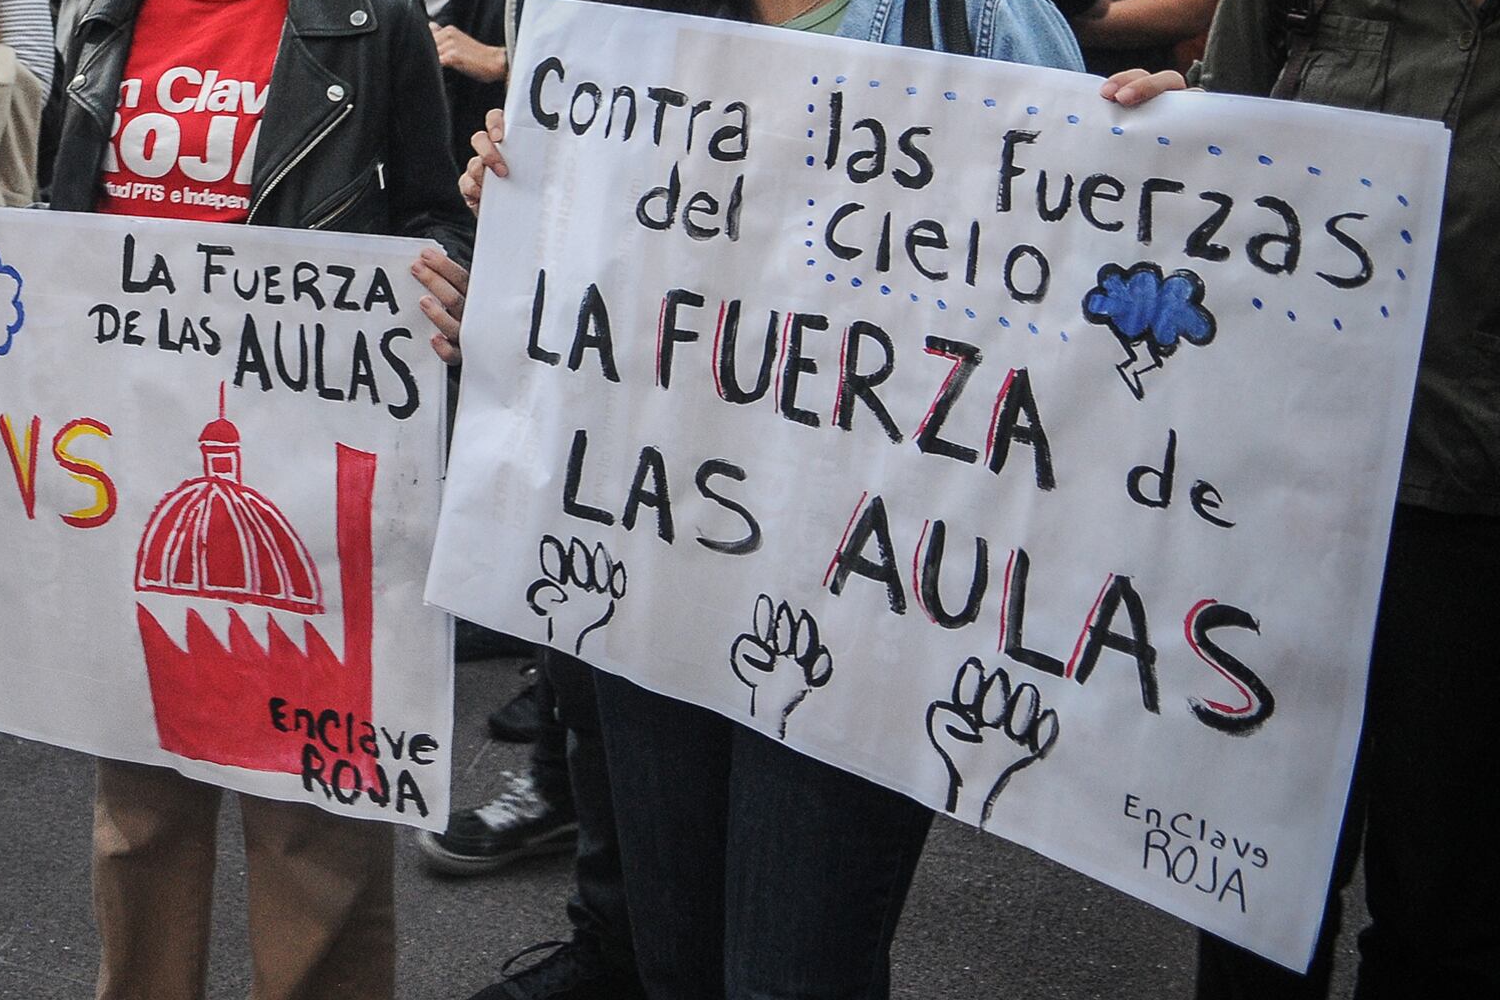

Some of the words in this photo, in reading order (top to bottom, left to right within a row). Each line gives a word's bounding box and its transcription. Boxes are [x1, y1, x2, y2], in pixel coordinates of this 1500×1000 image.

[156, 66, 270, 114] Clav
[824, 89, 936, 189] las
[132, 183, 166, 202] PTS
[170, 191, 181, 203] e
[183, 186, 250, 210] Indepen
[636, 164, 742, 242] del
[121, 233, 175, 295] LA
[196, 244, 401, 315] FUERZA
[88, 303, 145, 346] DE
[158, 314, 222, 356] LAS
[233, 312, 421, 420] AULAS
[527, 270, 620, 384] LA
[655, 287, 1054, 492] FUERZA
[1127, 429, 1235, 527] de
[562, 430, 764, 556] LAS
[823, 490, 1278, 736] AULAS
[300, 745, 428, 818] ROJA
[1143, 829, 1246, 914] ROJA
